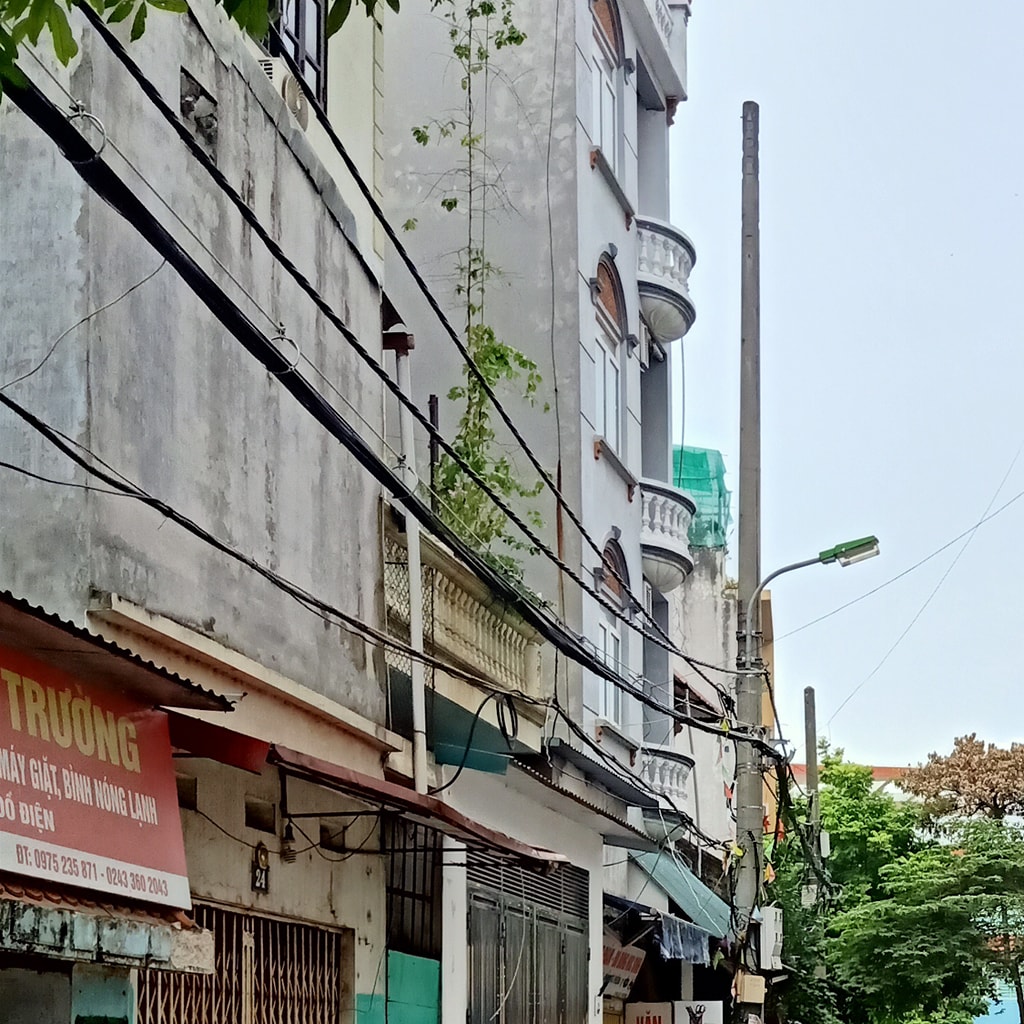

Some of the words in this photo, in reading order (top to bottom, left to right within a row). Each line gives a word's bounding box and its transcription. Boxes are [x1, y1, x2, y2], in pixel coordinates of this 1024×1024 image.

[1, 667, 141, 773] TRƯỜNG
[0, 745, 26, 786] MÁY
[62, 764, 93, 807] BÌNH
[93, 775, 128, 817] NÓNG
[128, 789, 158, 828] LẠNH
[19, 802, 55, 833] ĐIỆN
[16, 844, 33, 866] ĐT:
[34, 849, 59, 873] 0975
[61, 855, 79, 878] 235
[81, 860, 98, 881] 871
[106, 866, 128, 888] 0243
[130, 872, 146, 893] 360
[255, 868, 266, 889] 24
